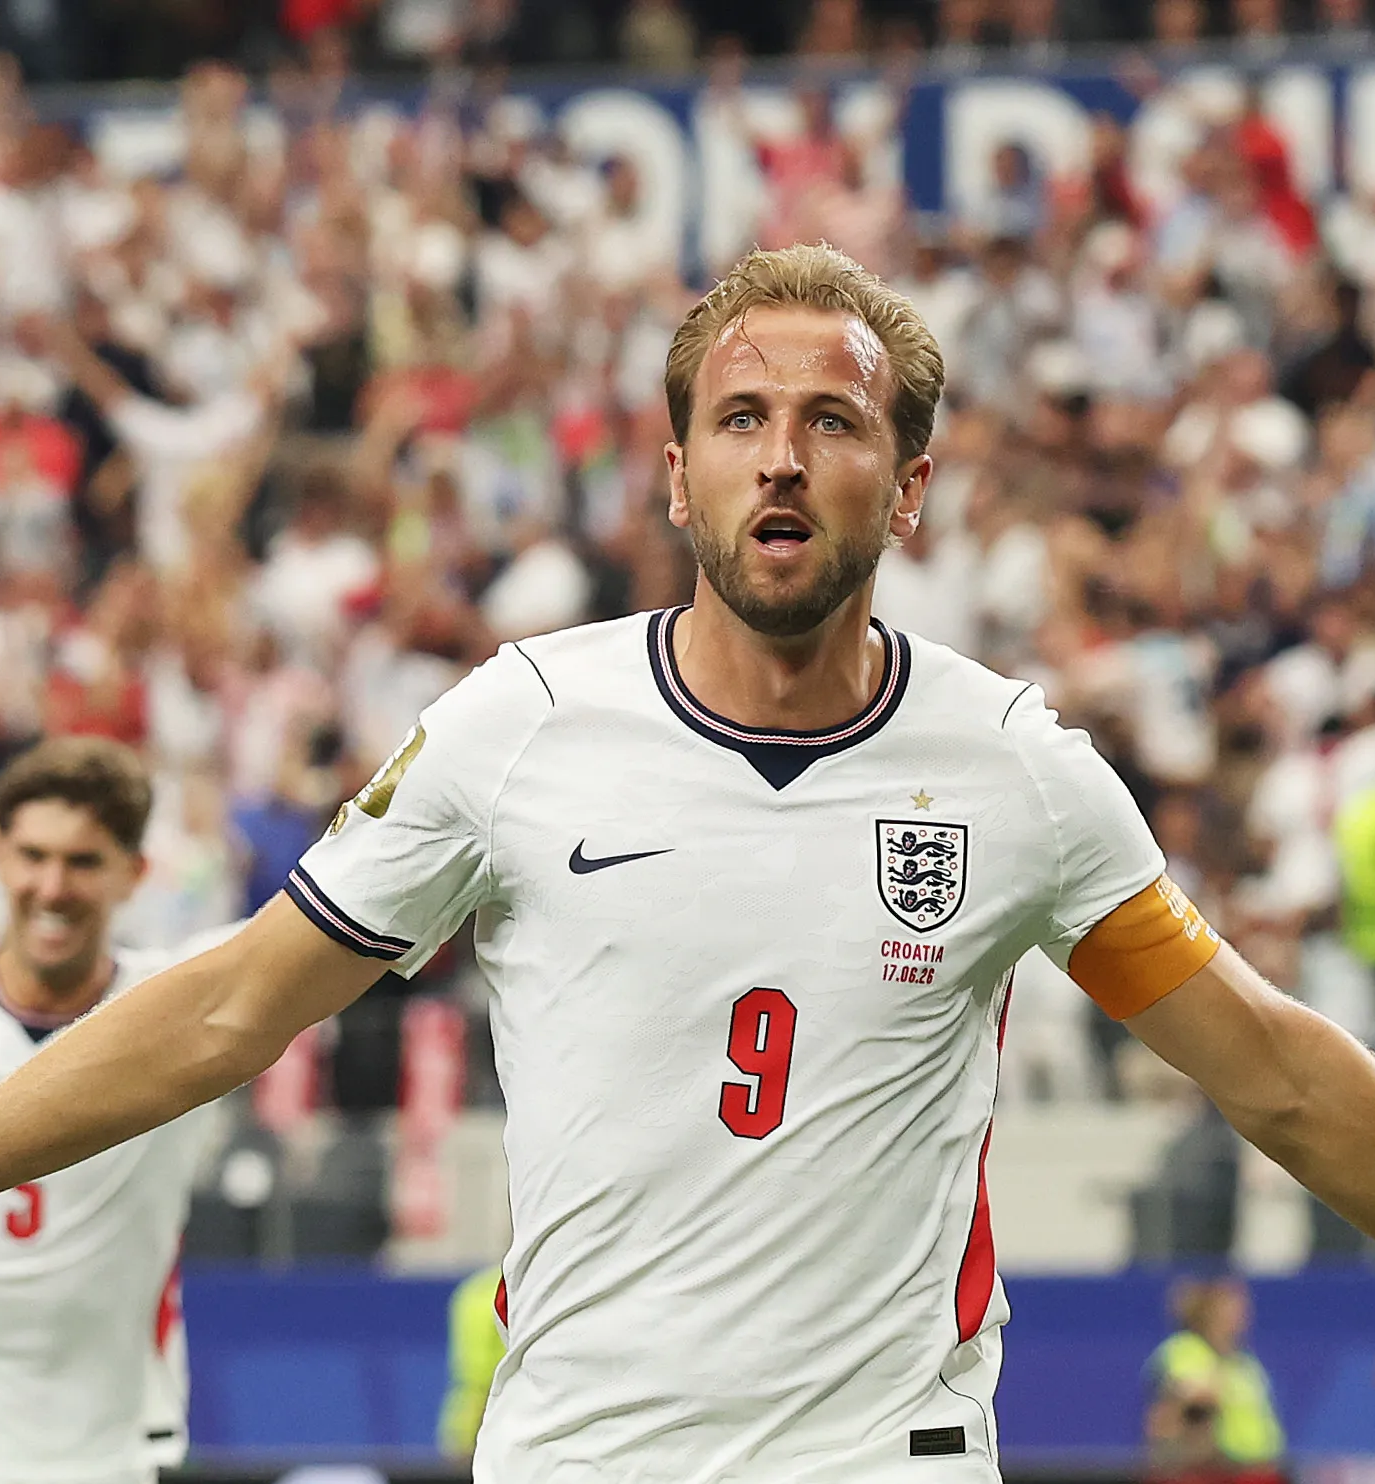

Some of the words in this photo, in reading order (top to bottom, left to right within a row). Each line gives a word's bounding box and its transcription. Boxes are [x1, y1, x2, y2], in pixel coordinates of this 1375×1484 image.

[881, 940, 944, 963] CROATIA
[882, 963, 935, 985] 17.06.26
[718, 987, 798, 1140] 9
